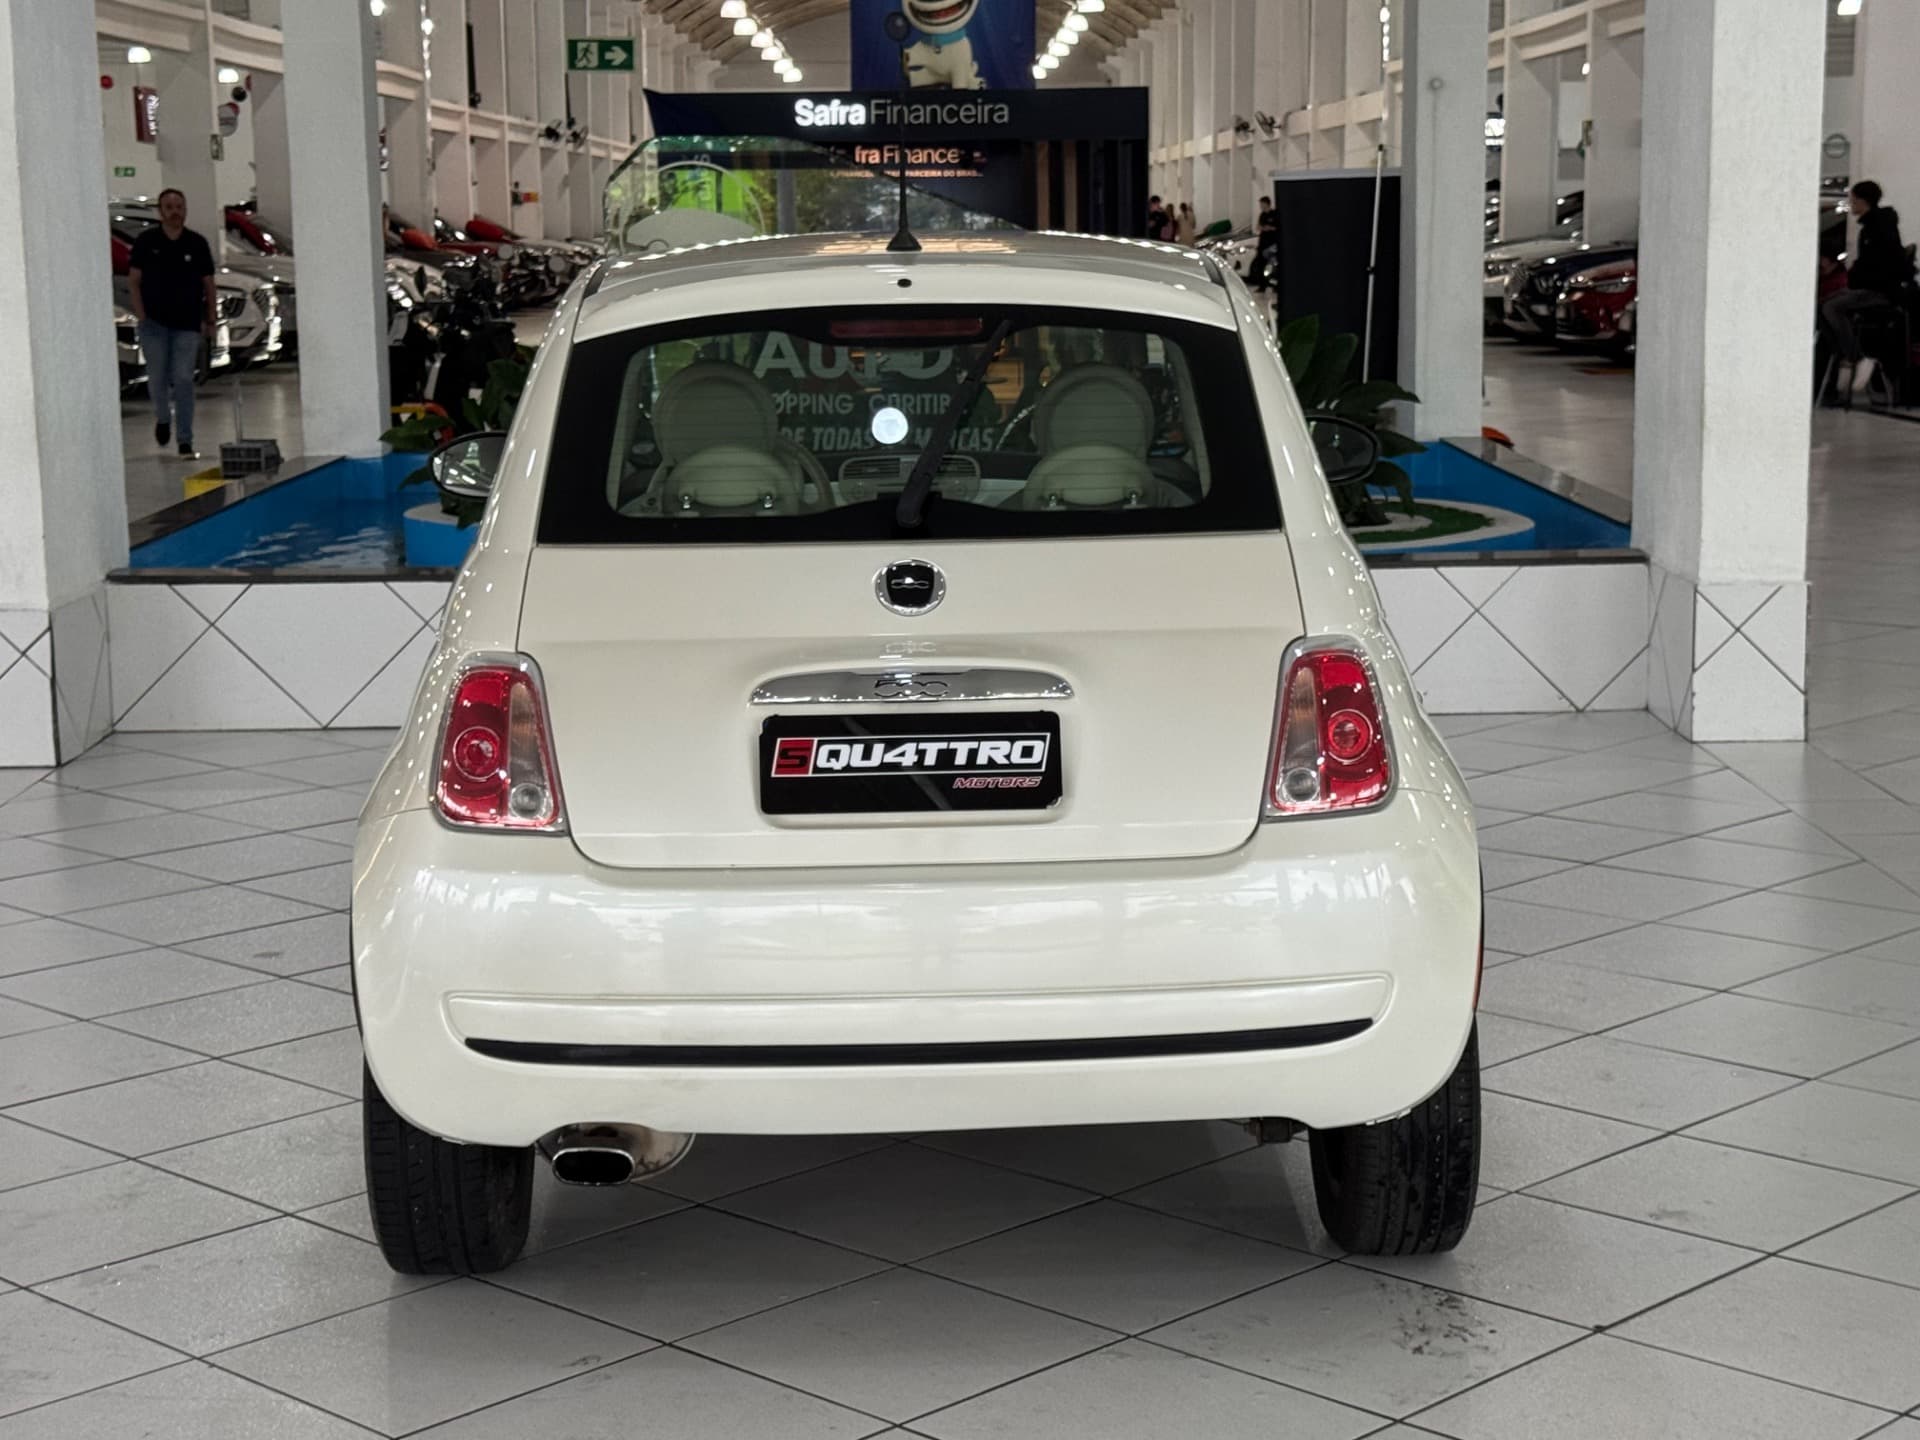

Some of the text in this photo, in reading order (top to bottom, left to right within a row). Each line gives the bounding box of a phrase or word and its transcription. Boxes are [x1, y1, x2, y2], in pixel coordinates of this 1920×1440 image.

[794, 98, 1010, 127] Safra Financeira
[952, 776, 1043, 789] MOTORS
